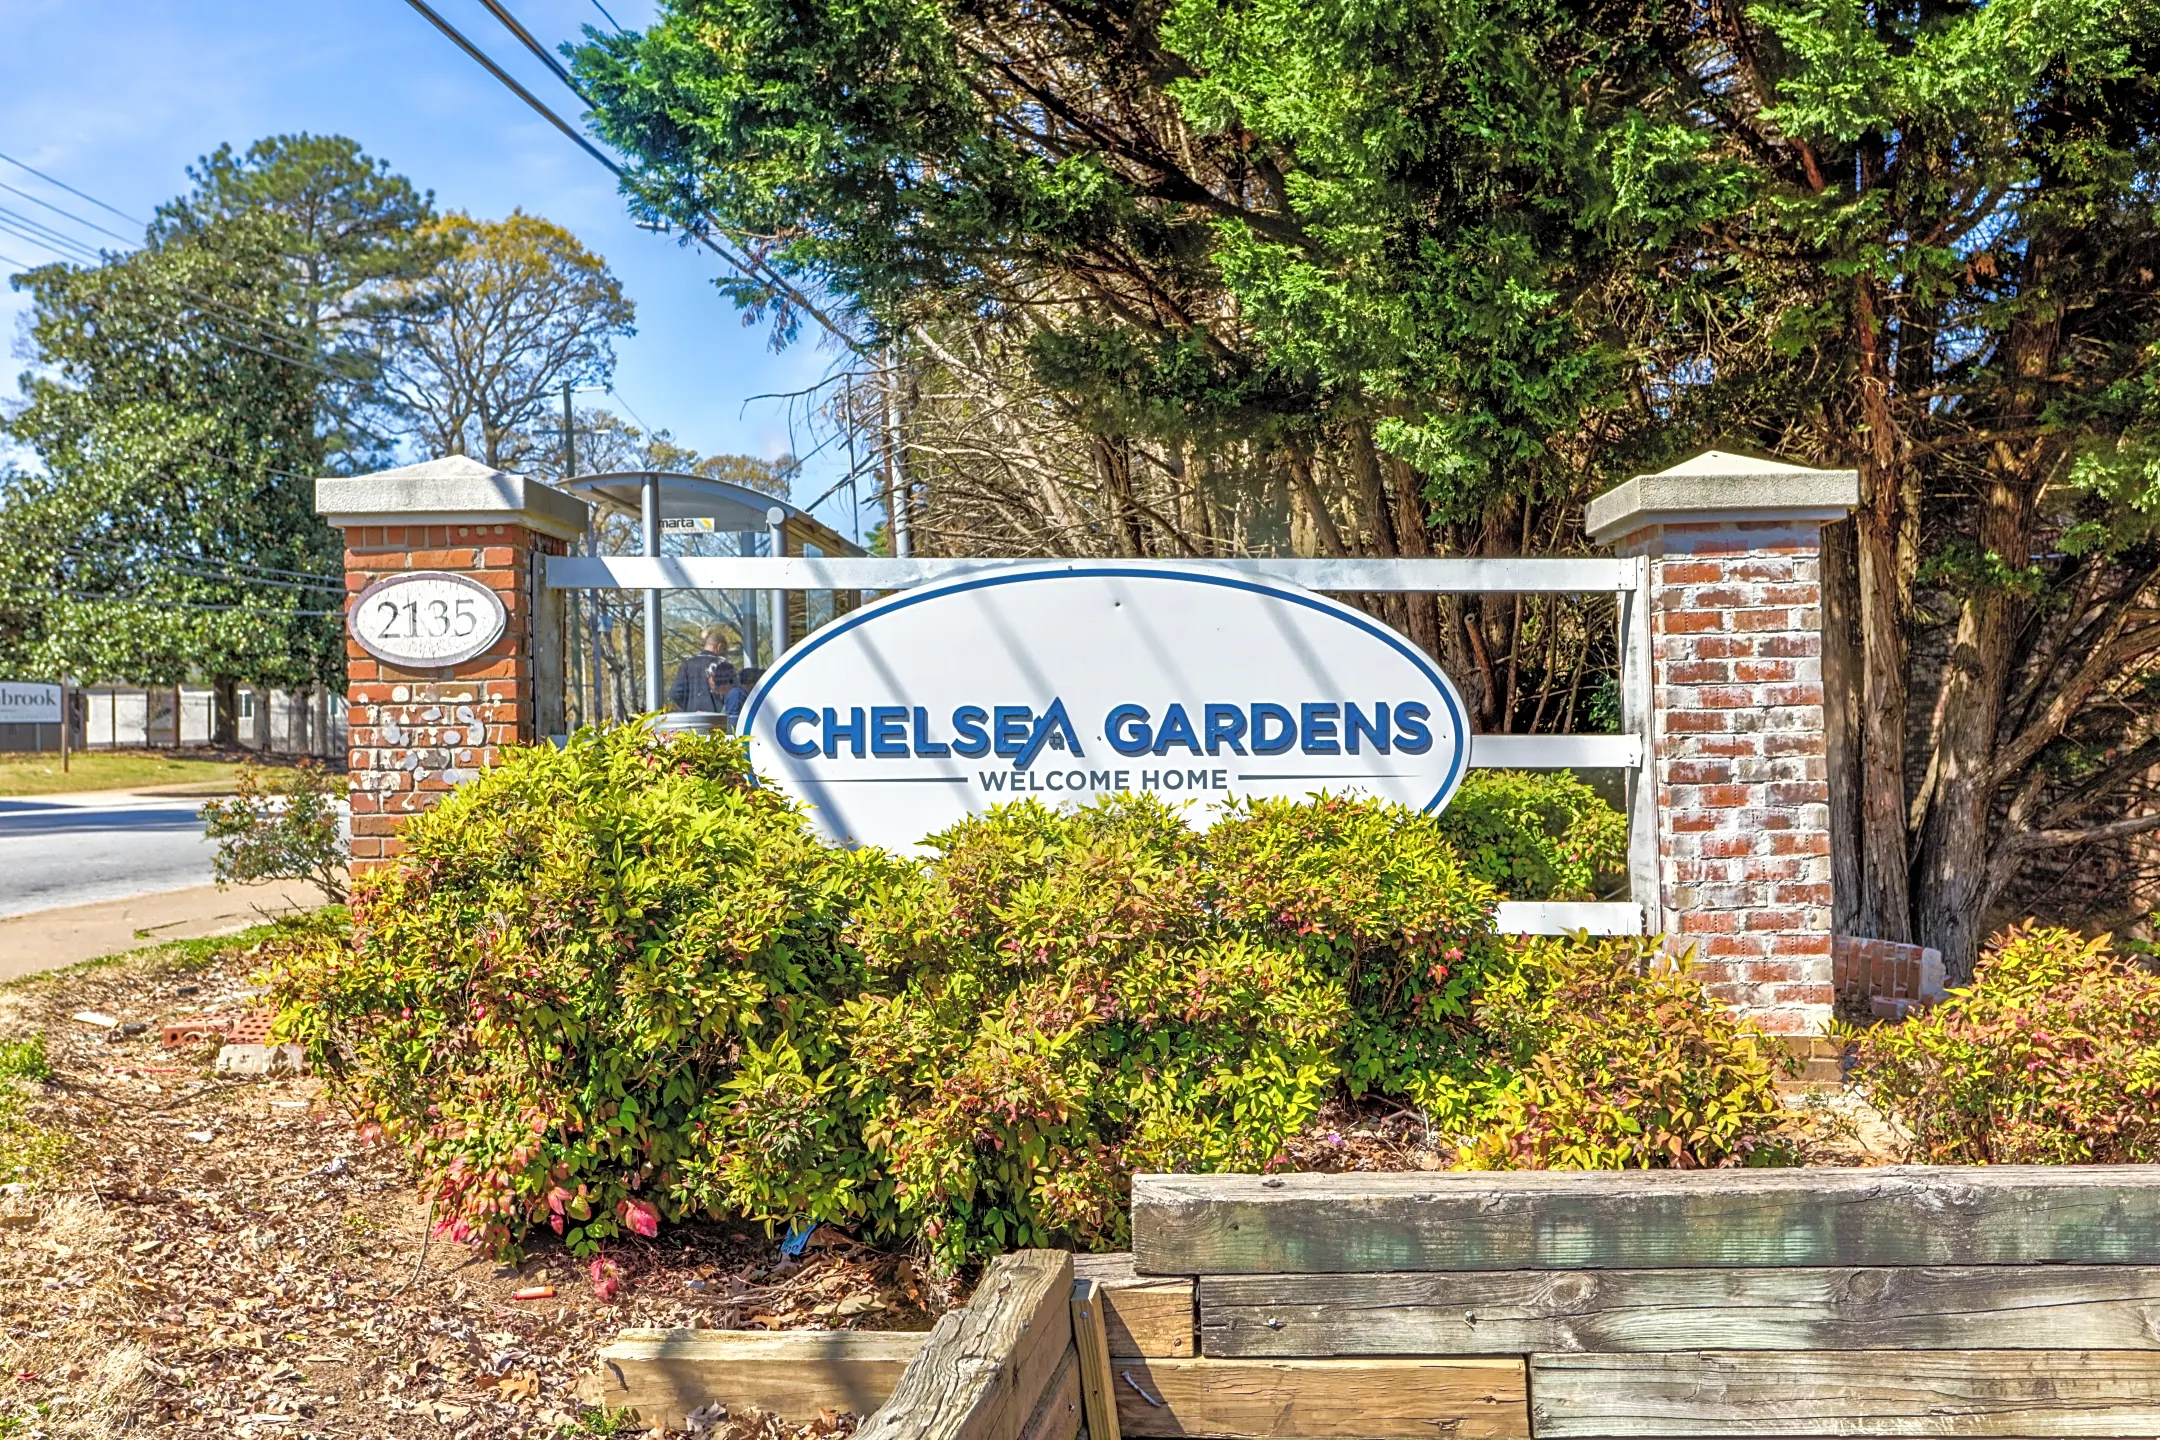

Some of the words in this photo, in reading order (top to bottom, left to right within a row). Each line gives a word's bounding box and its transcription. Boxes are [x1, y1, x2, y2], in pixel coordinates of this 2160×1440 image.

[658, 518, 694, 528] marta
[377, 599, 477, 639] 2135
[2, 688, 57, 706] brook
[775, 696, 1086, 771] CHELSEA
[1104, 701, 1434, 758] GARDENS
[978, 769, 1130, 792] WELCOME
[1142, 769, 1228, 791] HOME
